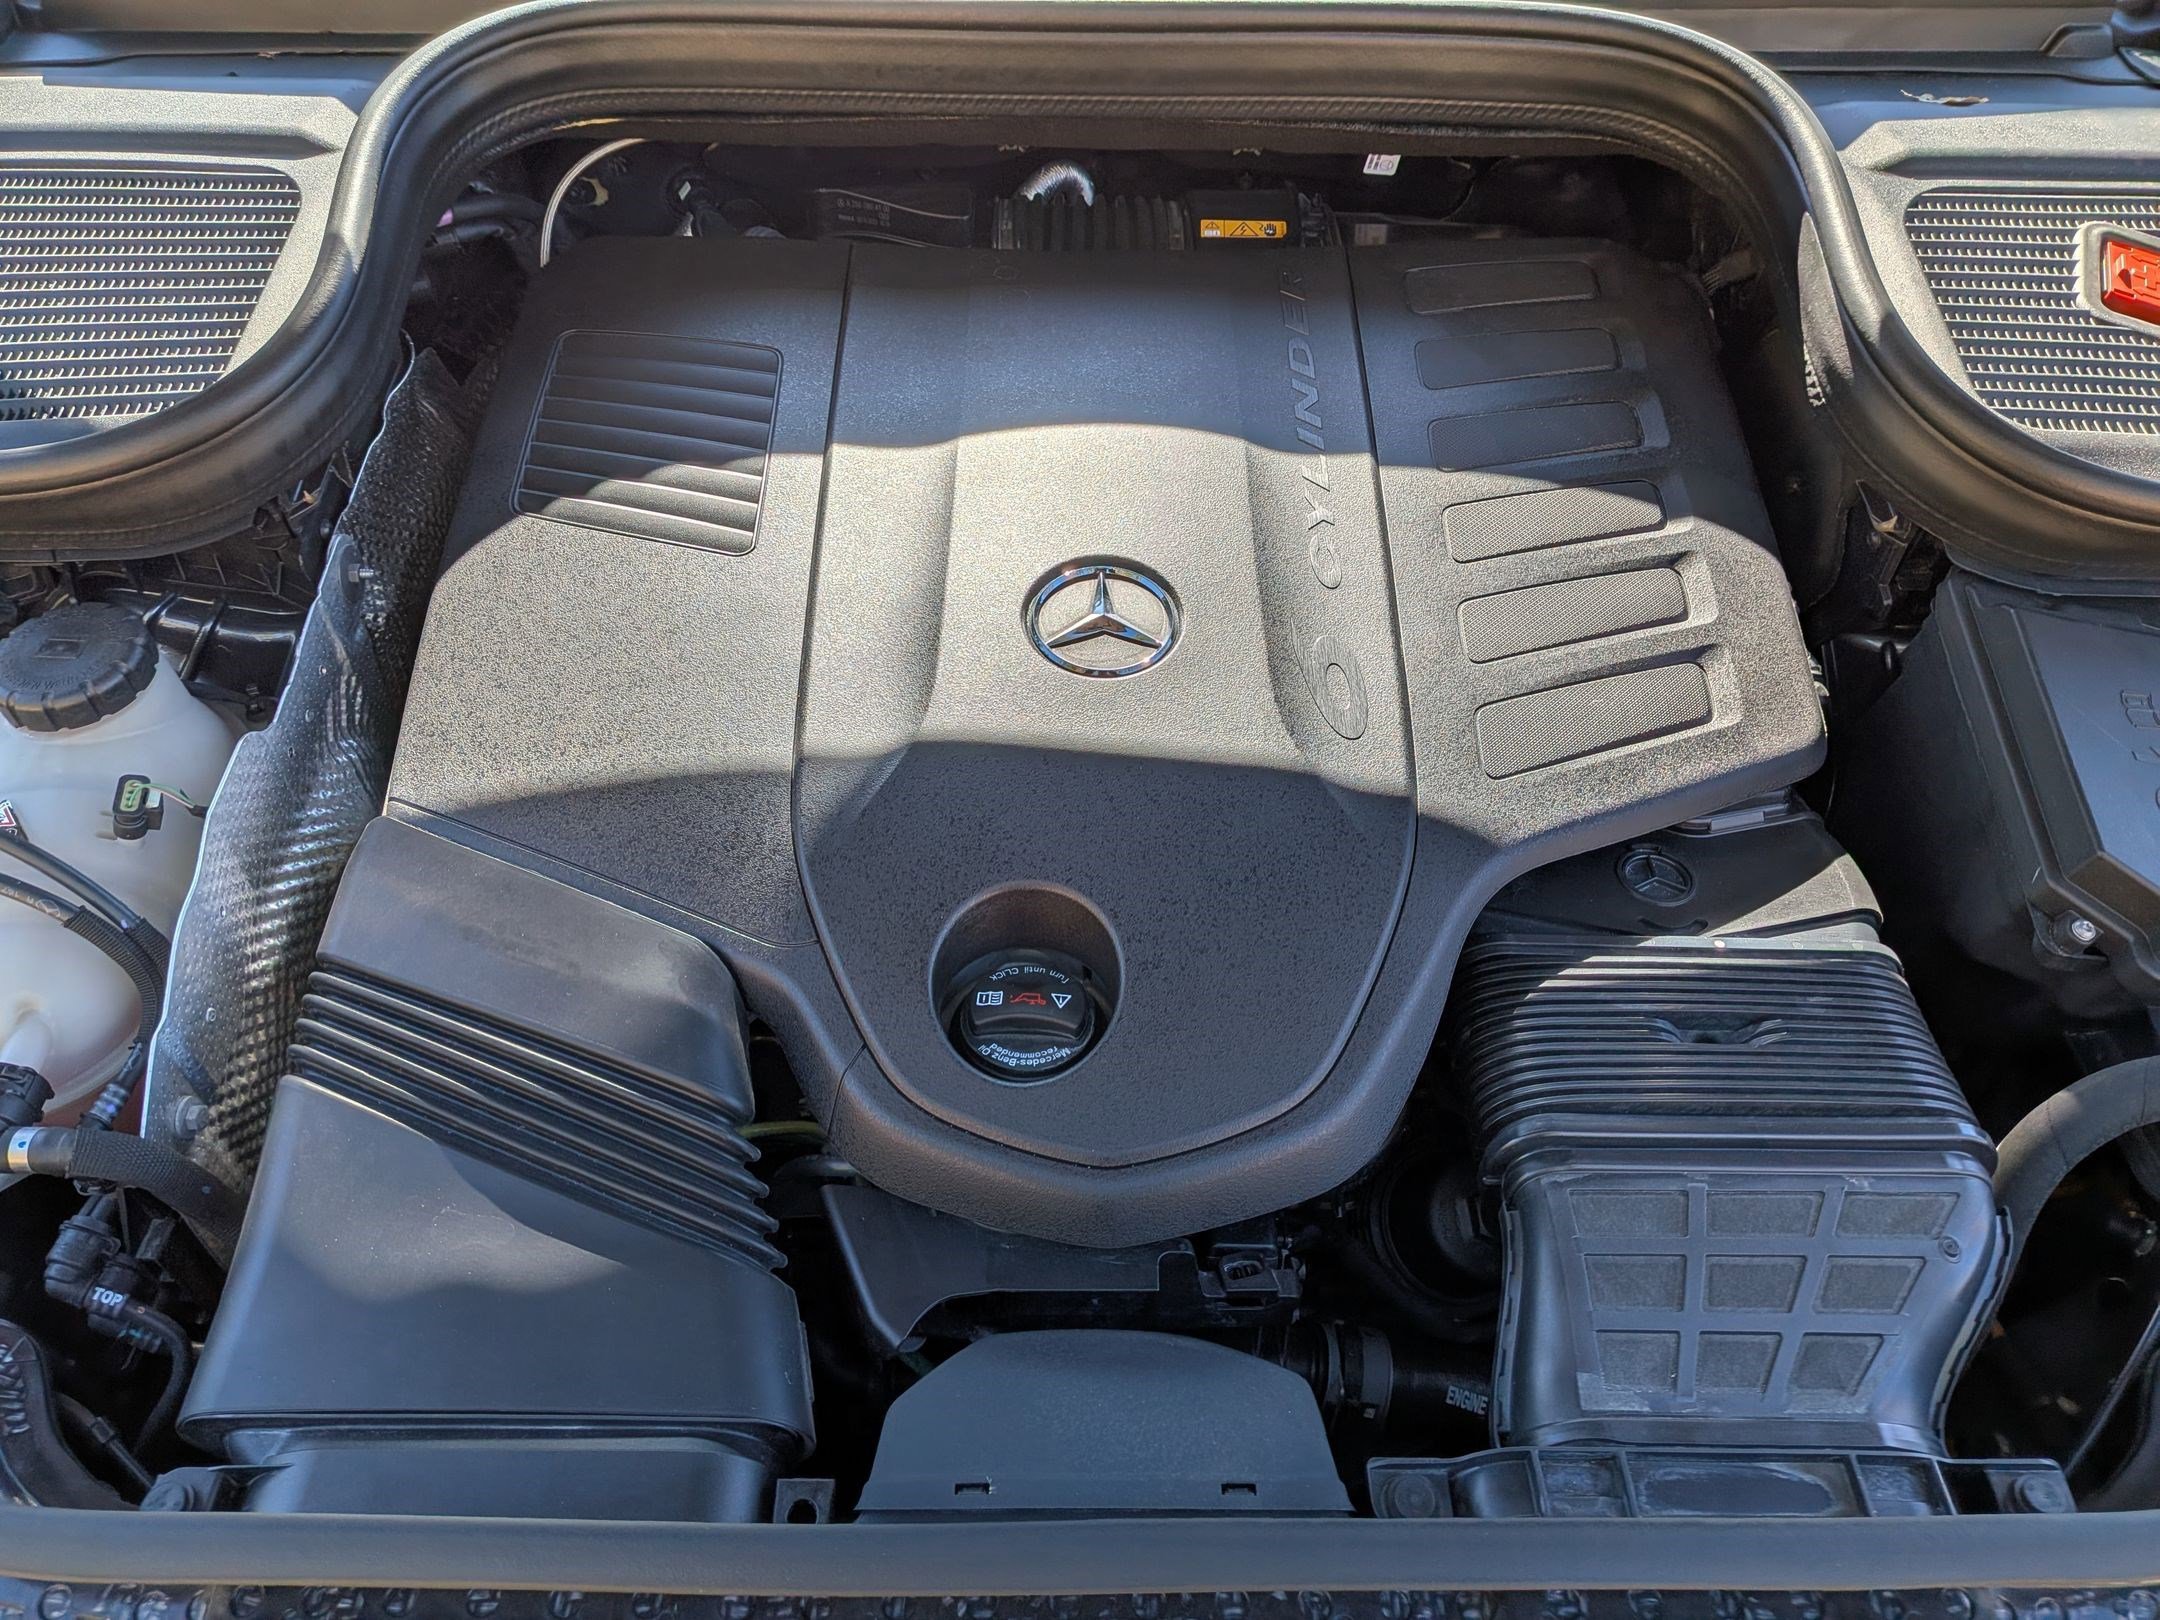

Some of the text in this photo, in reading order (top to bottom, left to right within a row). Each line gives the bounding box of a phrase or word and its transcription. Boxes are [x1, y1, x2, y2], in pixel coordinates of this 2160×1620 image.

[1278, 270, 1369, 740] 6 CYLINDER
[989, 966, 1069, 984] Turn until CLICK
[977, 1044, 1071, 1066] Mercedes-Benz Oil
[990, 1042, 1057, 1058] recommended
[92, 1286, 124, 1307] TOP
[1445, 1385, 1489, 1415] ENGINE
